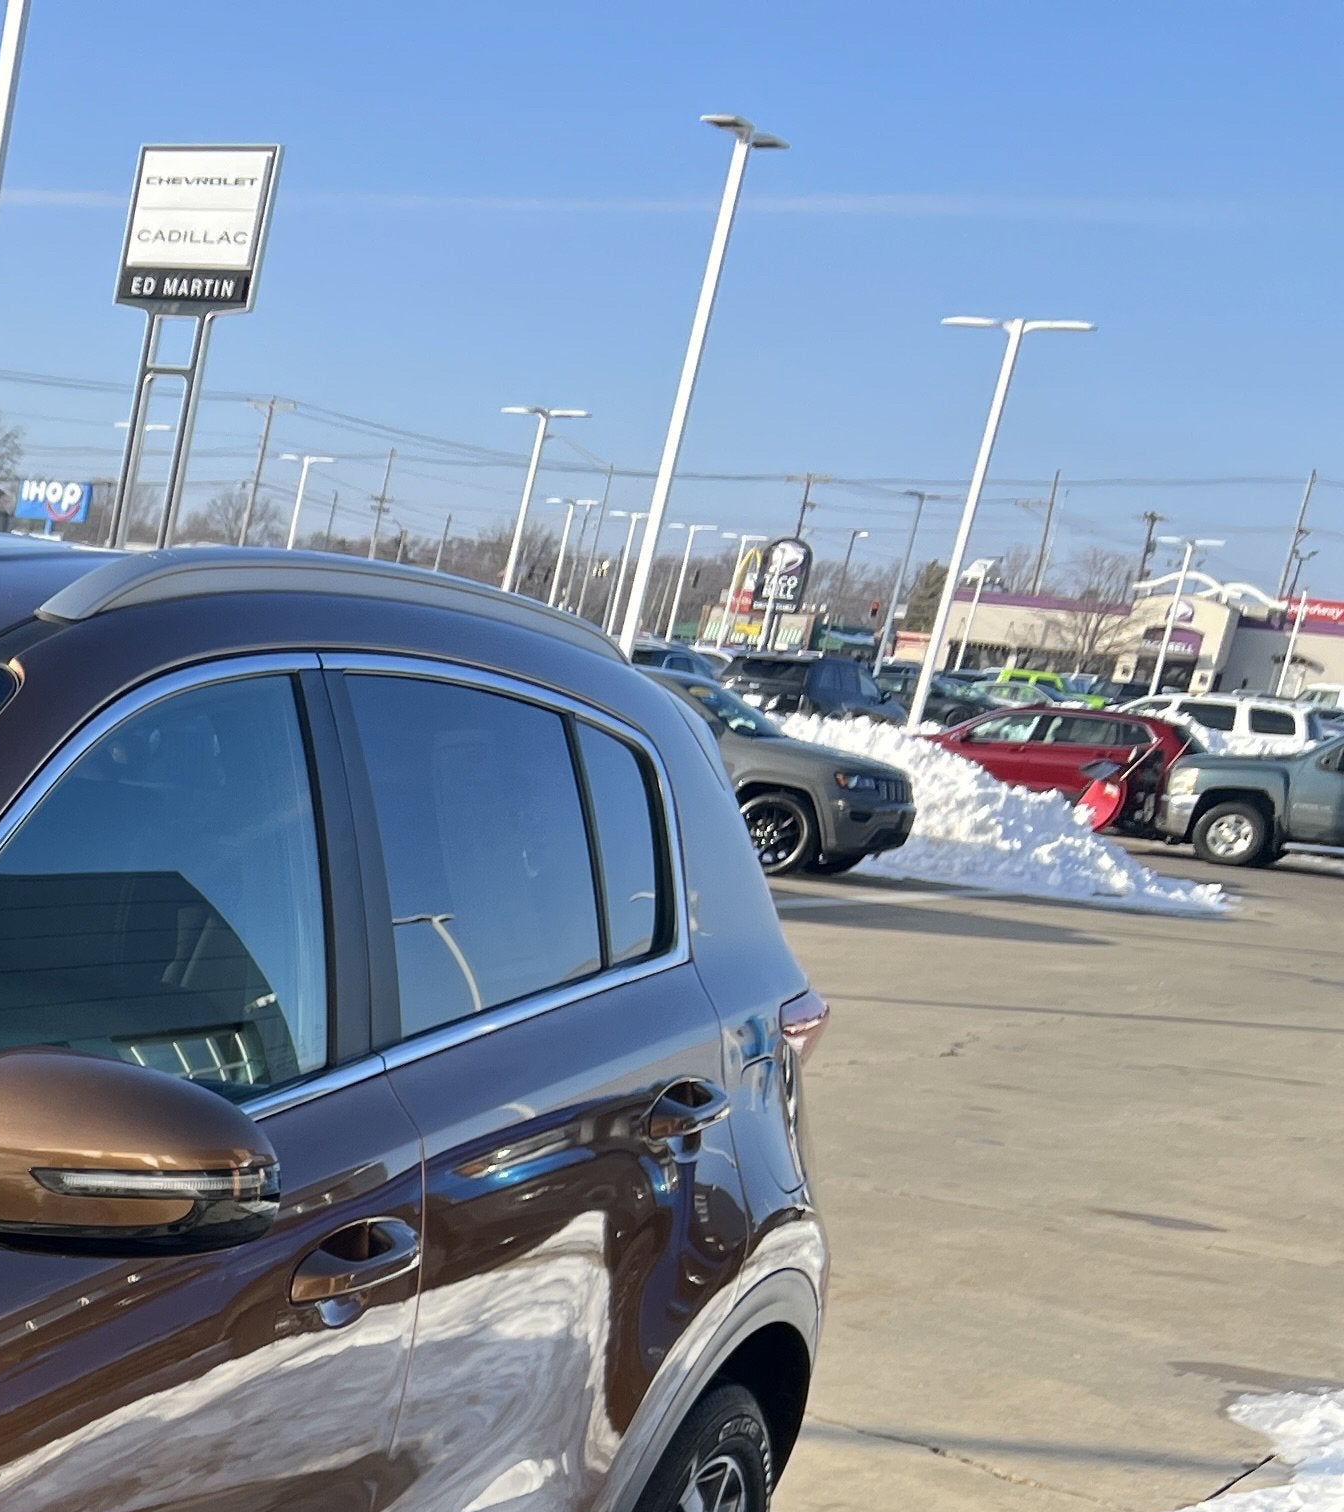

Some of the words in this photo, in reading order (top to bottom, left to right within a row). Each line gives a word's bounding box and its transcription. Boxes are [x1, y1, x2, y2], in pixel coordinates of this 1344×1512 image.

[145, 175, 258, 187] CHEVROLET
[136, 228, 249, 246] CADILLAC
[130, 276, 157, 297] ED
[162, 276, 235, 299] MARTIN
